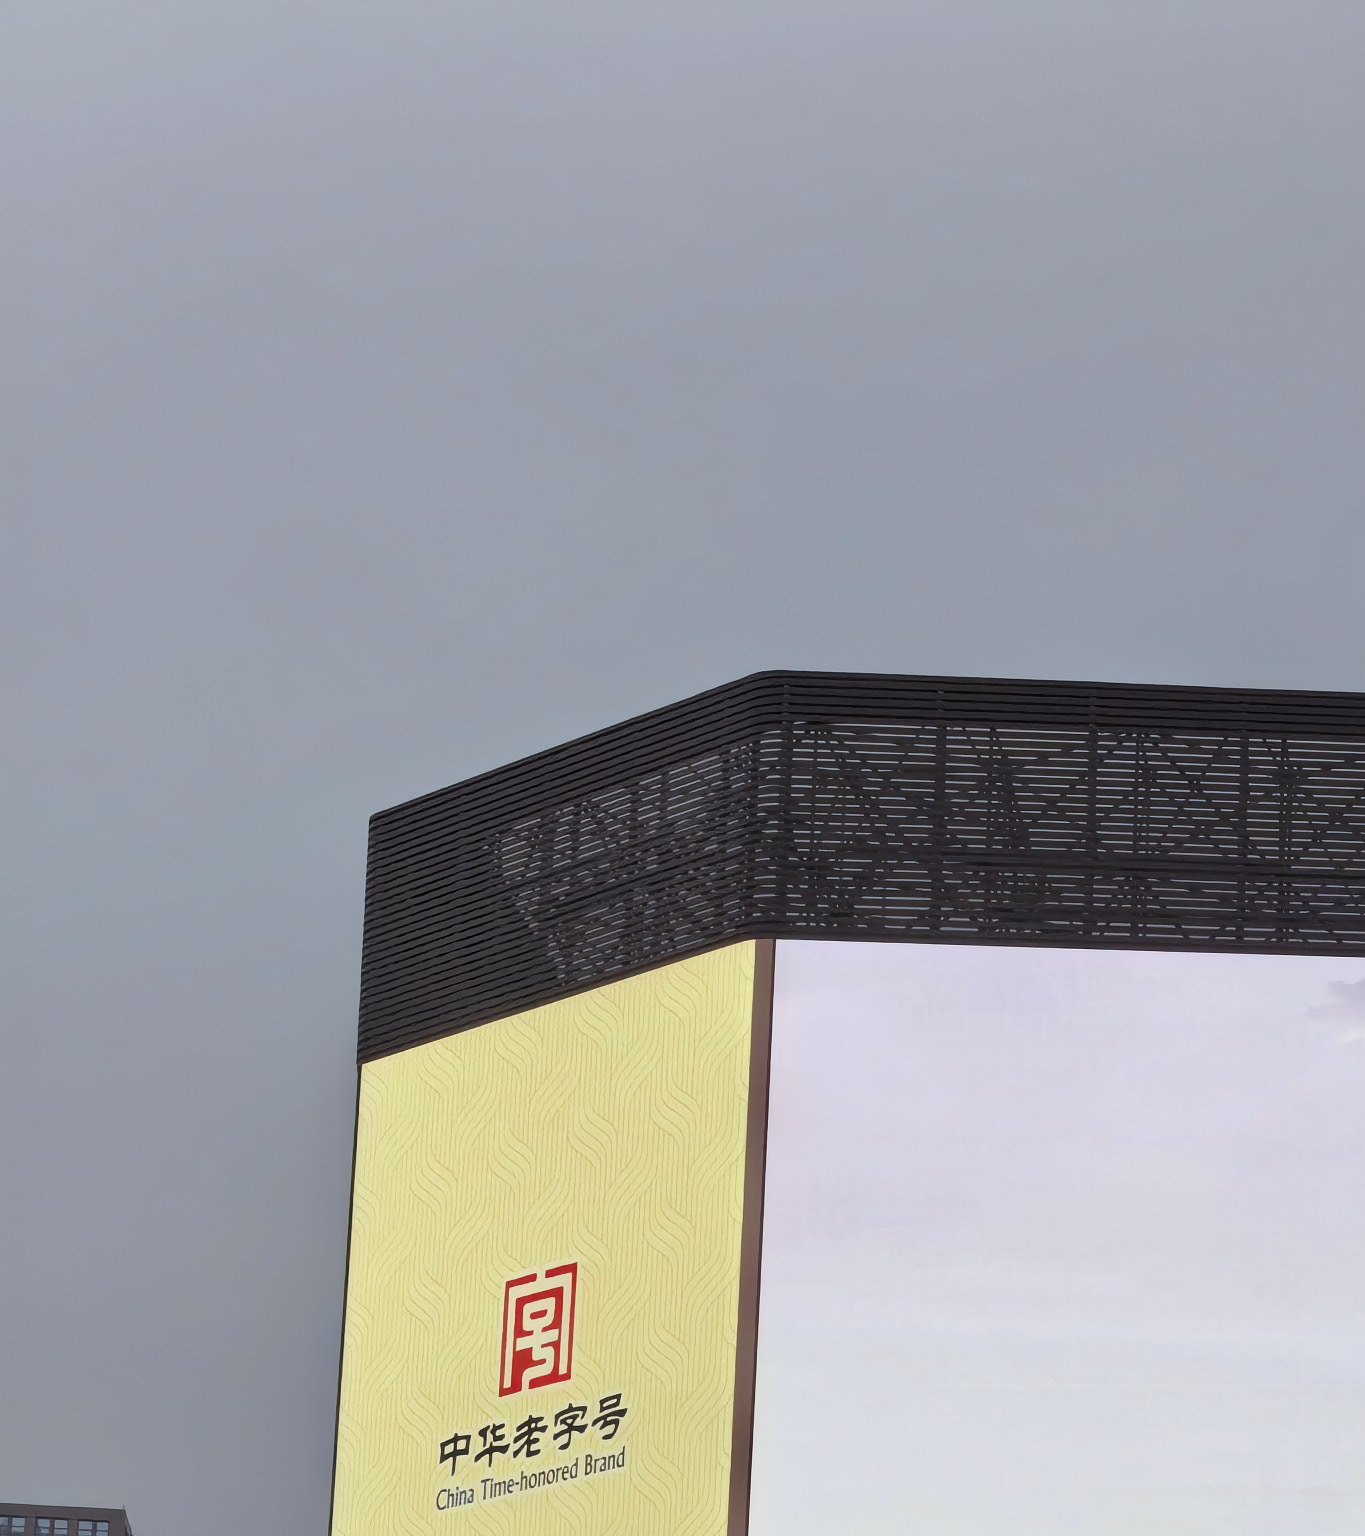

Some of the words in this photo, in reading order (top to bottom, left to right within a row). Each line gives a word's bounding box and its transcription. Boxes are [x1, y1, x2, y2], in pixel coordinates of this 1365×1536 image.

[438, 1392, 628, 1476] 中华老字号
[436, 1485, 475, 1511] China
[481, 1466, 579, 1502] Time-honored
[584, 1447, 626, 1476] Brand
